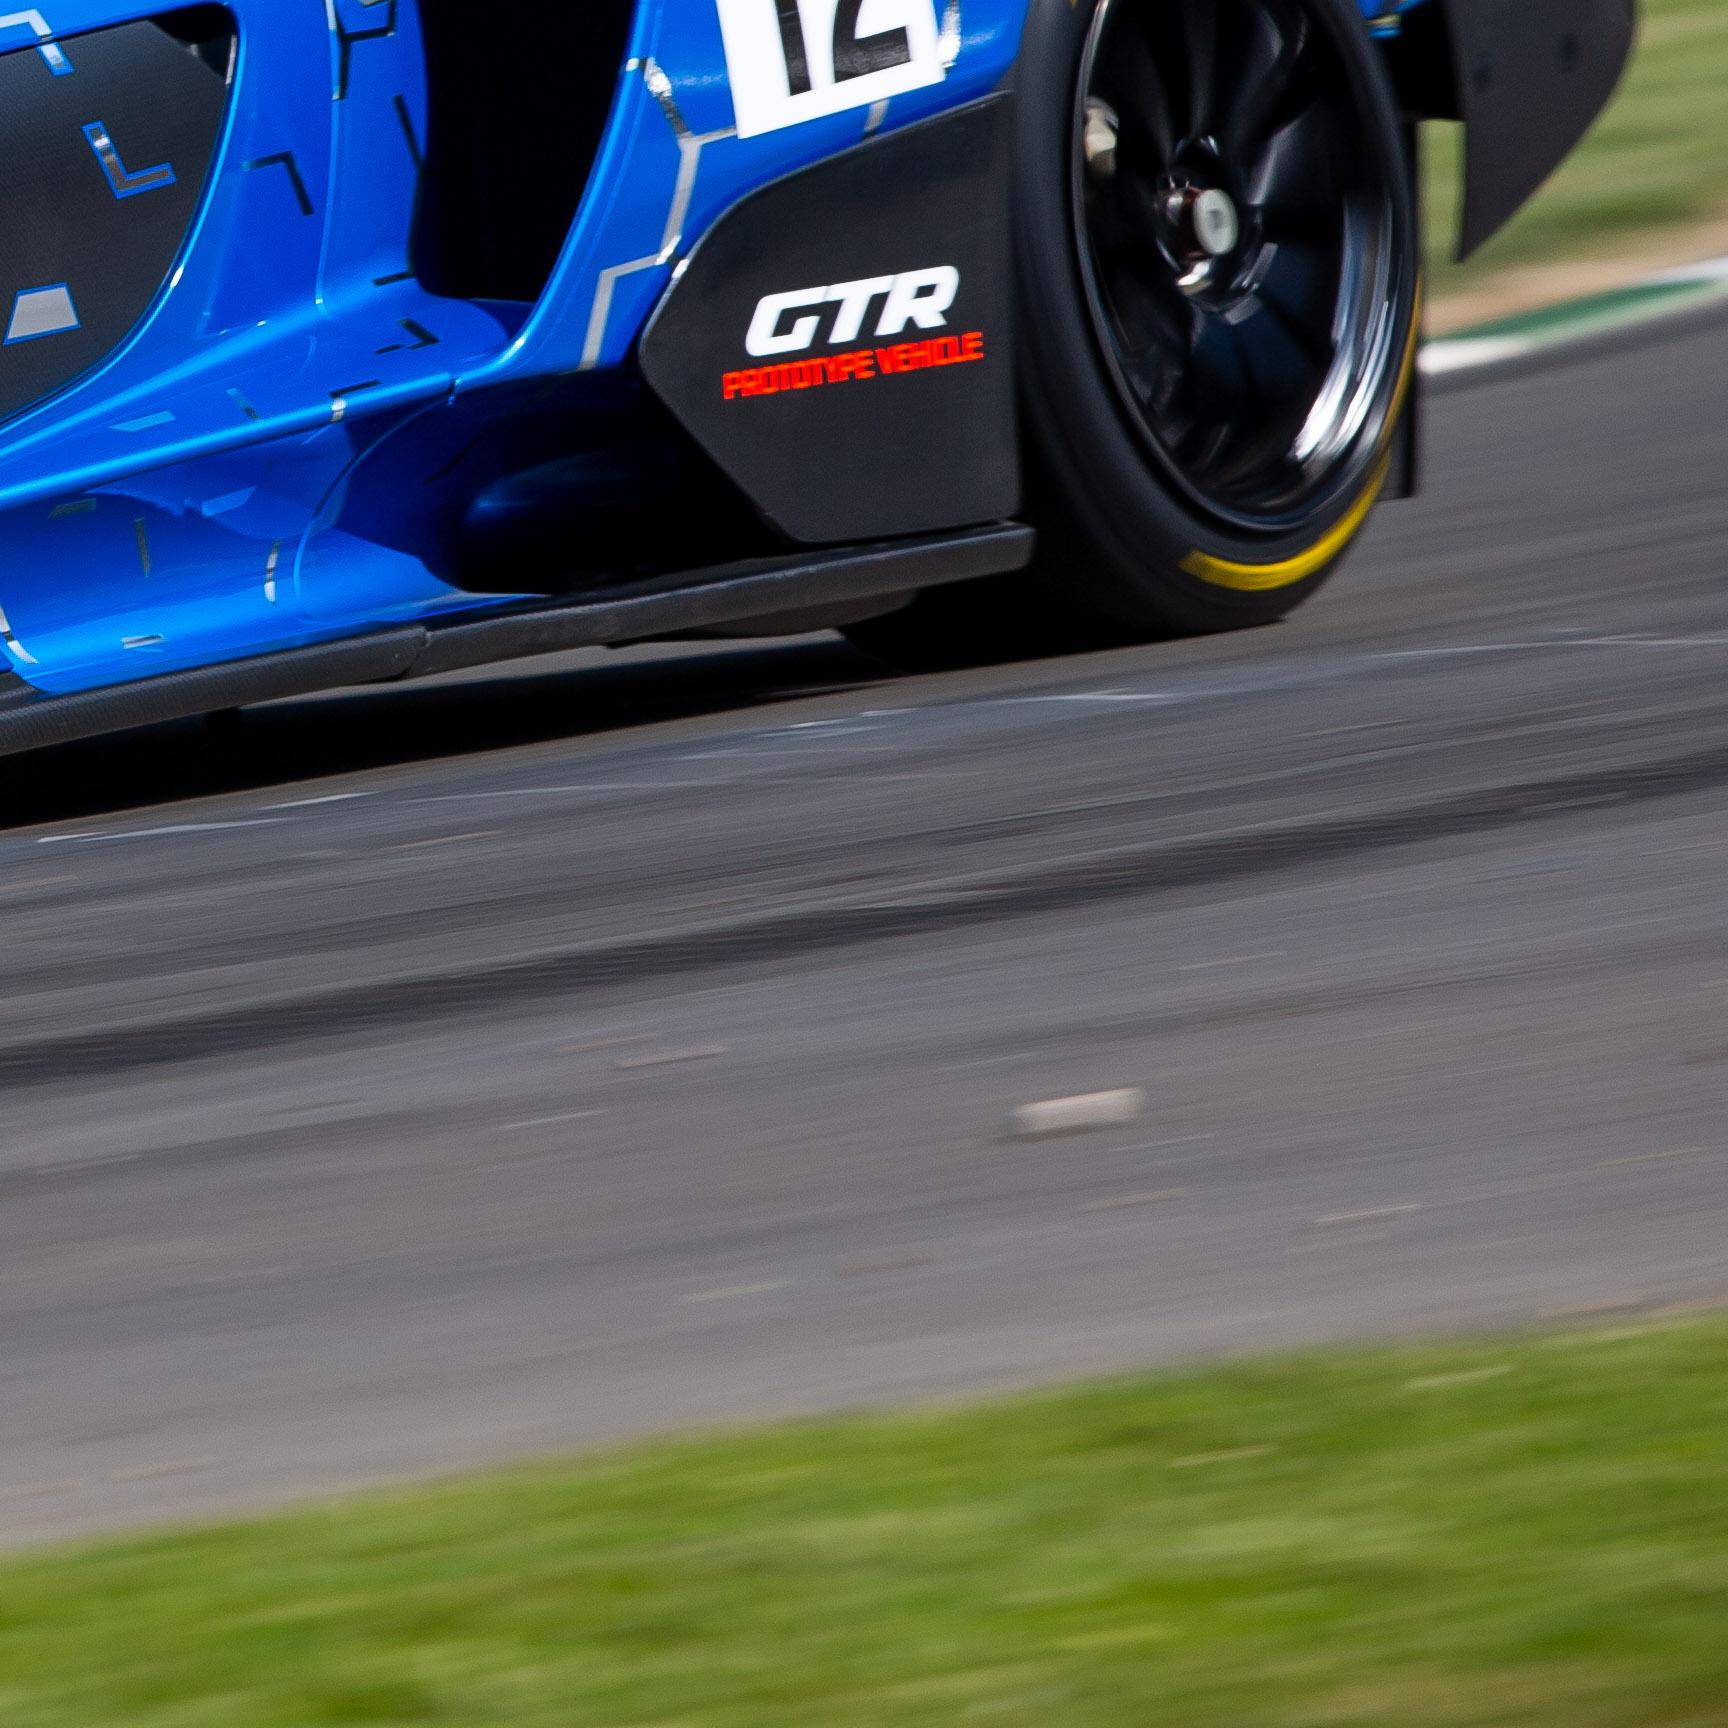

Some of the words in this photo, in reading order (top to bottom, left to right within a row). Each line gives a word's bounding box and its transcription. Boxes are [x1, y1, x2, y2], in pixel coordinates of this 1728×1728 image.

[745, 265, 960, 357] GTR
[722, 349, 877, 401] PROTOTYPE
[873, 330, 985, 376] VEHICLE
